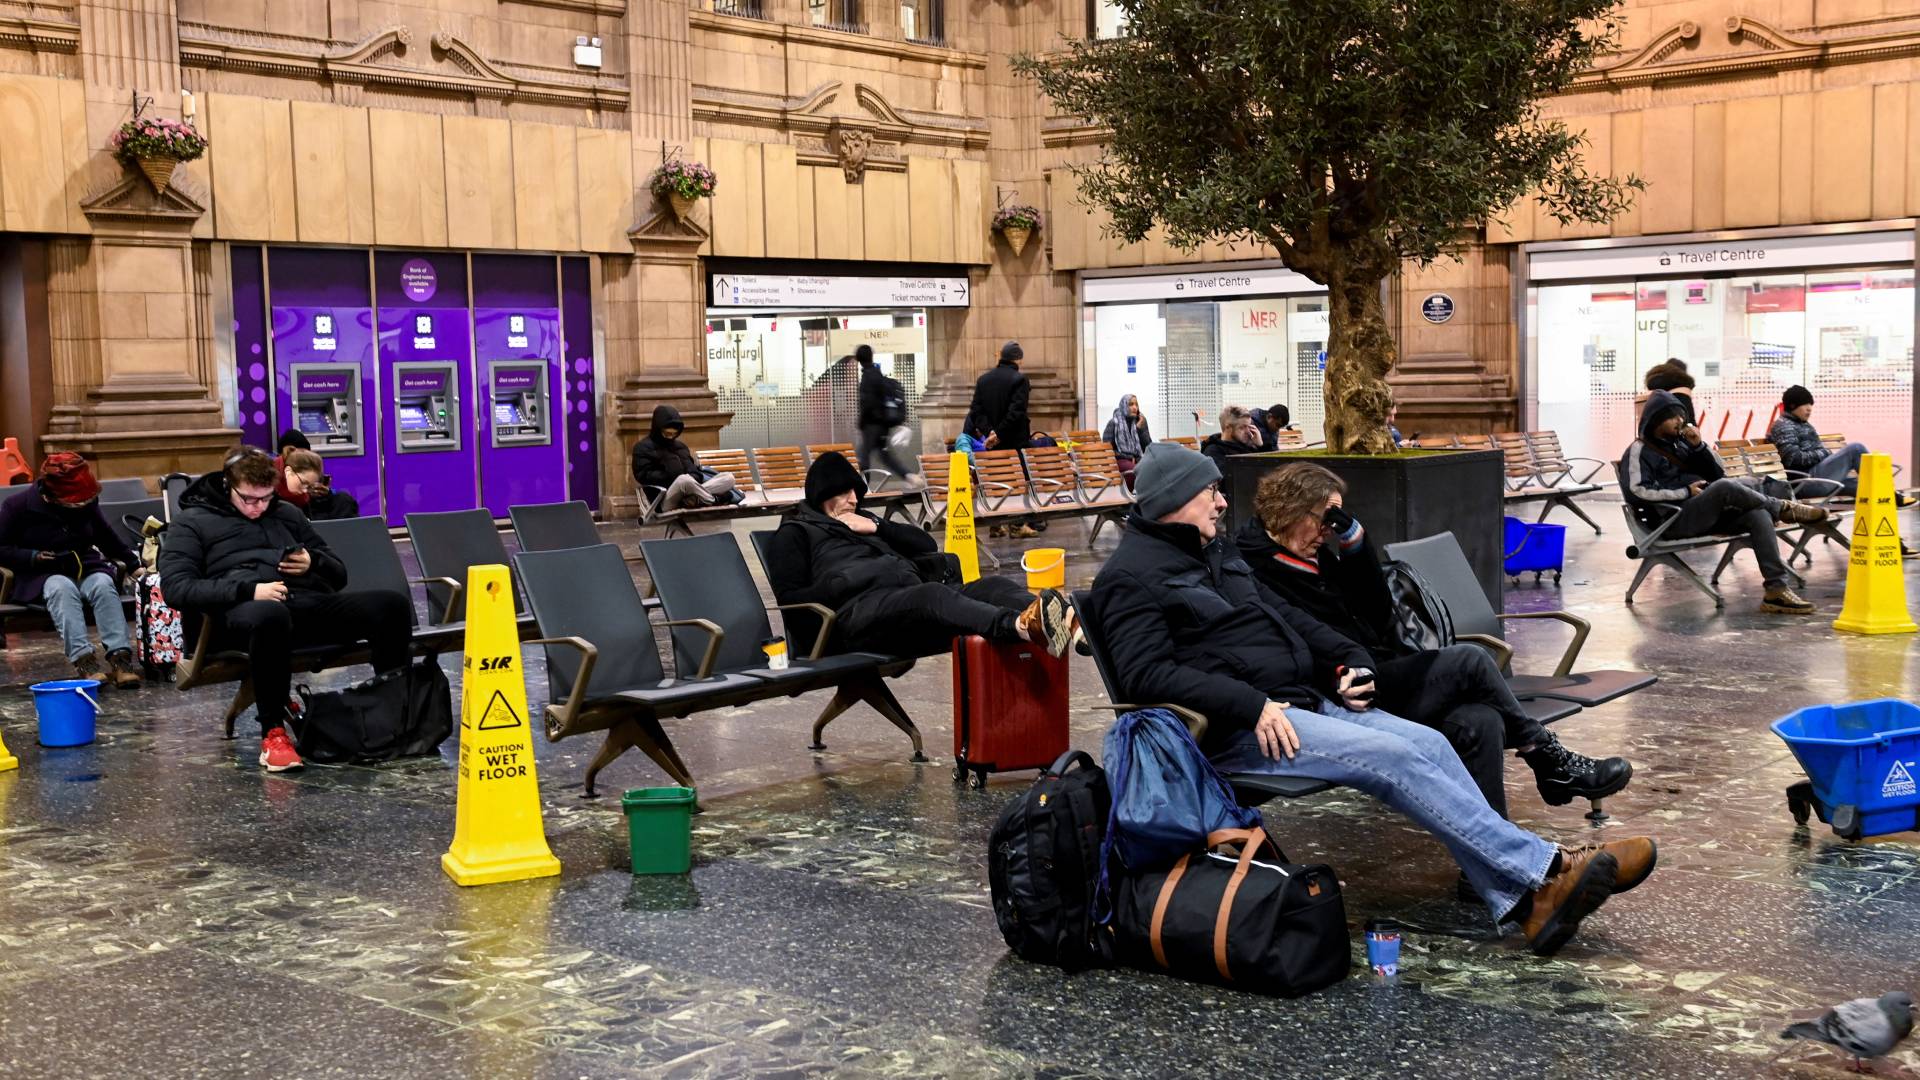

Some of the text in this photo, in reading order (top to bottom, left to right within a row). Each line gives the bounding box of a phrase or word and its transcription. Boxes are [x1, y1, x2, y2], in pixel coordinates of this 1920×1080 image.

[1678, 249, 1765, 263] Travel Centre
[917, 280, 937, 288] Centre
[1189, 277, 1251, 288] Travel Centre
[891, 293, 908, 301] Ticket
[1241, 309, 1278, 329] LNER
[864, 331, 888, 340] LNER
[479, 656, 512, 671] SIR
[478, 743, 524, 755] CAUTION
[486, 753, 518, 767] WET
[479, 765, 527, 780] FLOOR
[1882, 783, 1916, 793] CAUTION
